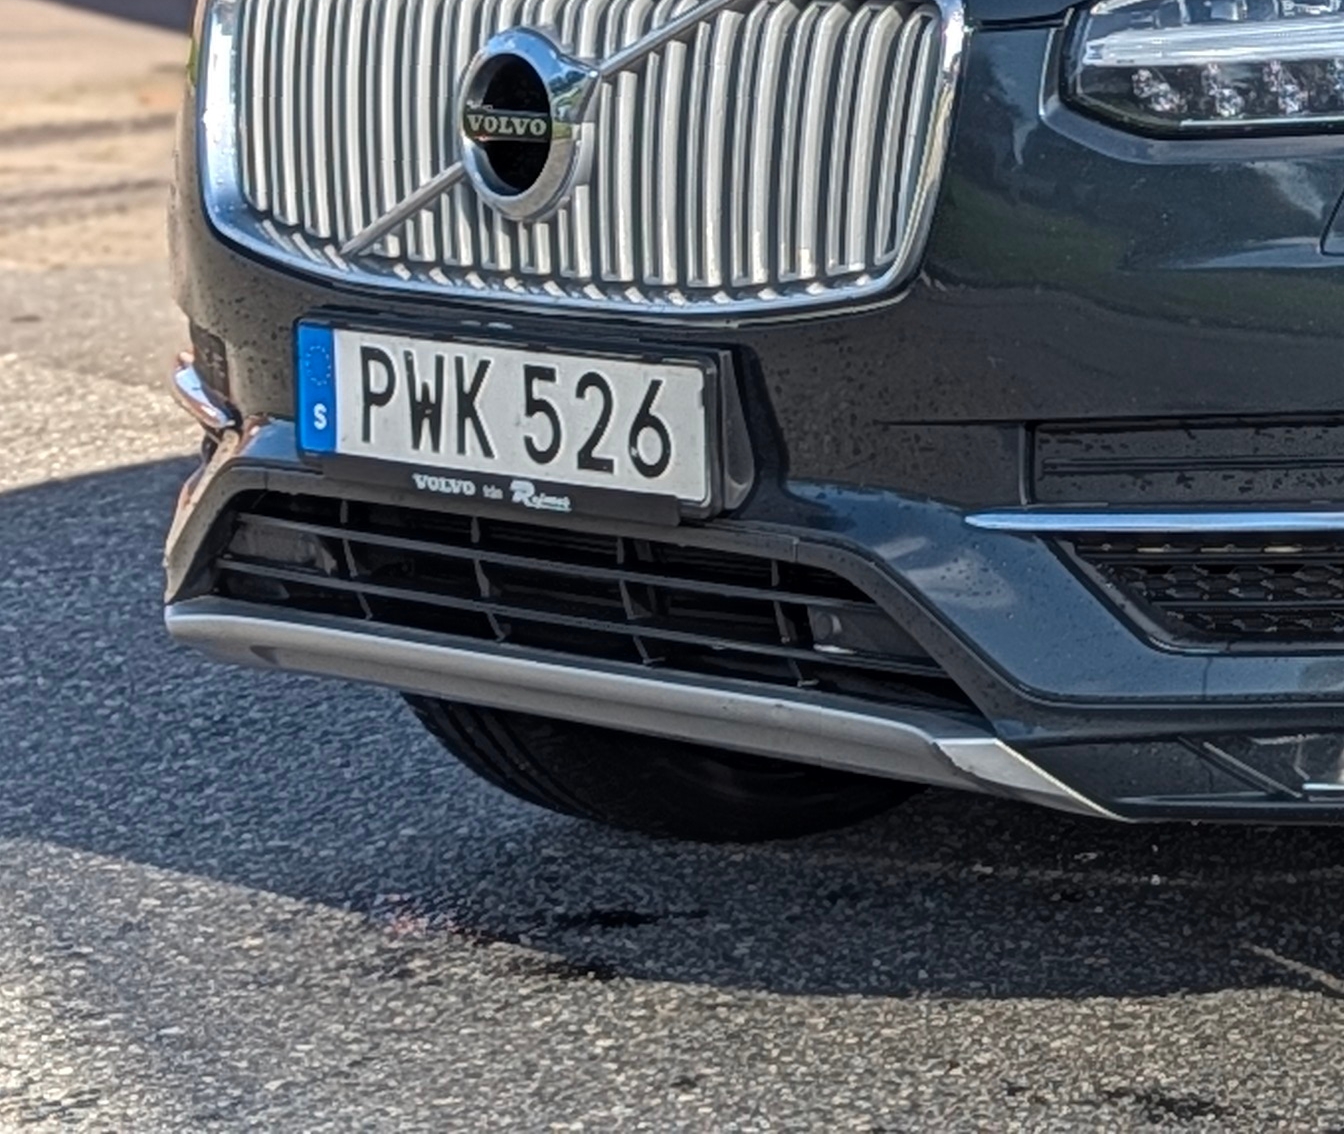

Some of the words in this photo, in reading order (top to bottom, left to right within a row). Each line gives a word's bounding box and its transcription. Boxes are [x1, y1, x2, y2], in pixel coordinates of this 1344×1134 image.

[466, 114, 547, 136] VOLVO
[313, 403, 327, 430] S
[359, 344, 497, 459] PWK
[523, 363, 672, 478] 526
[412, 473, 476, 496] VOLVO
